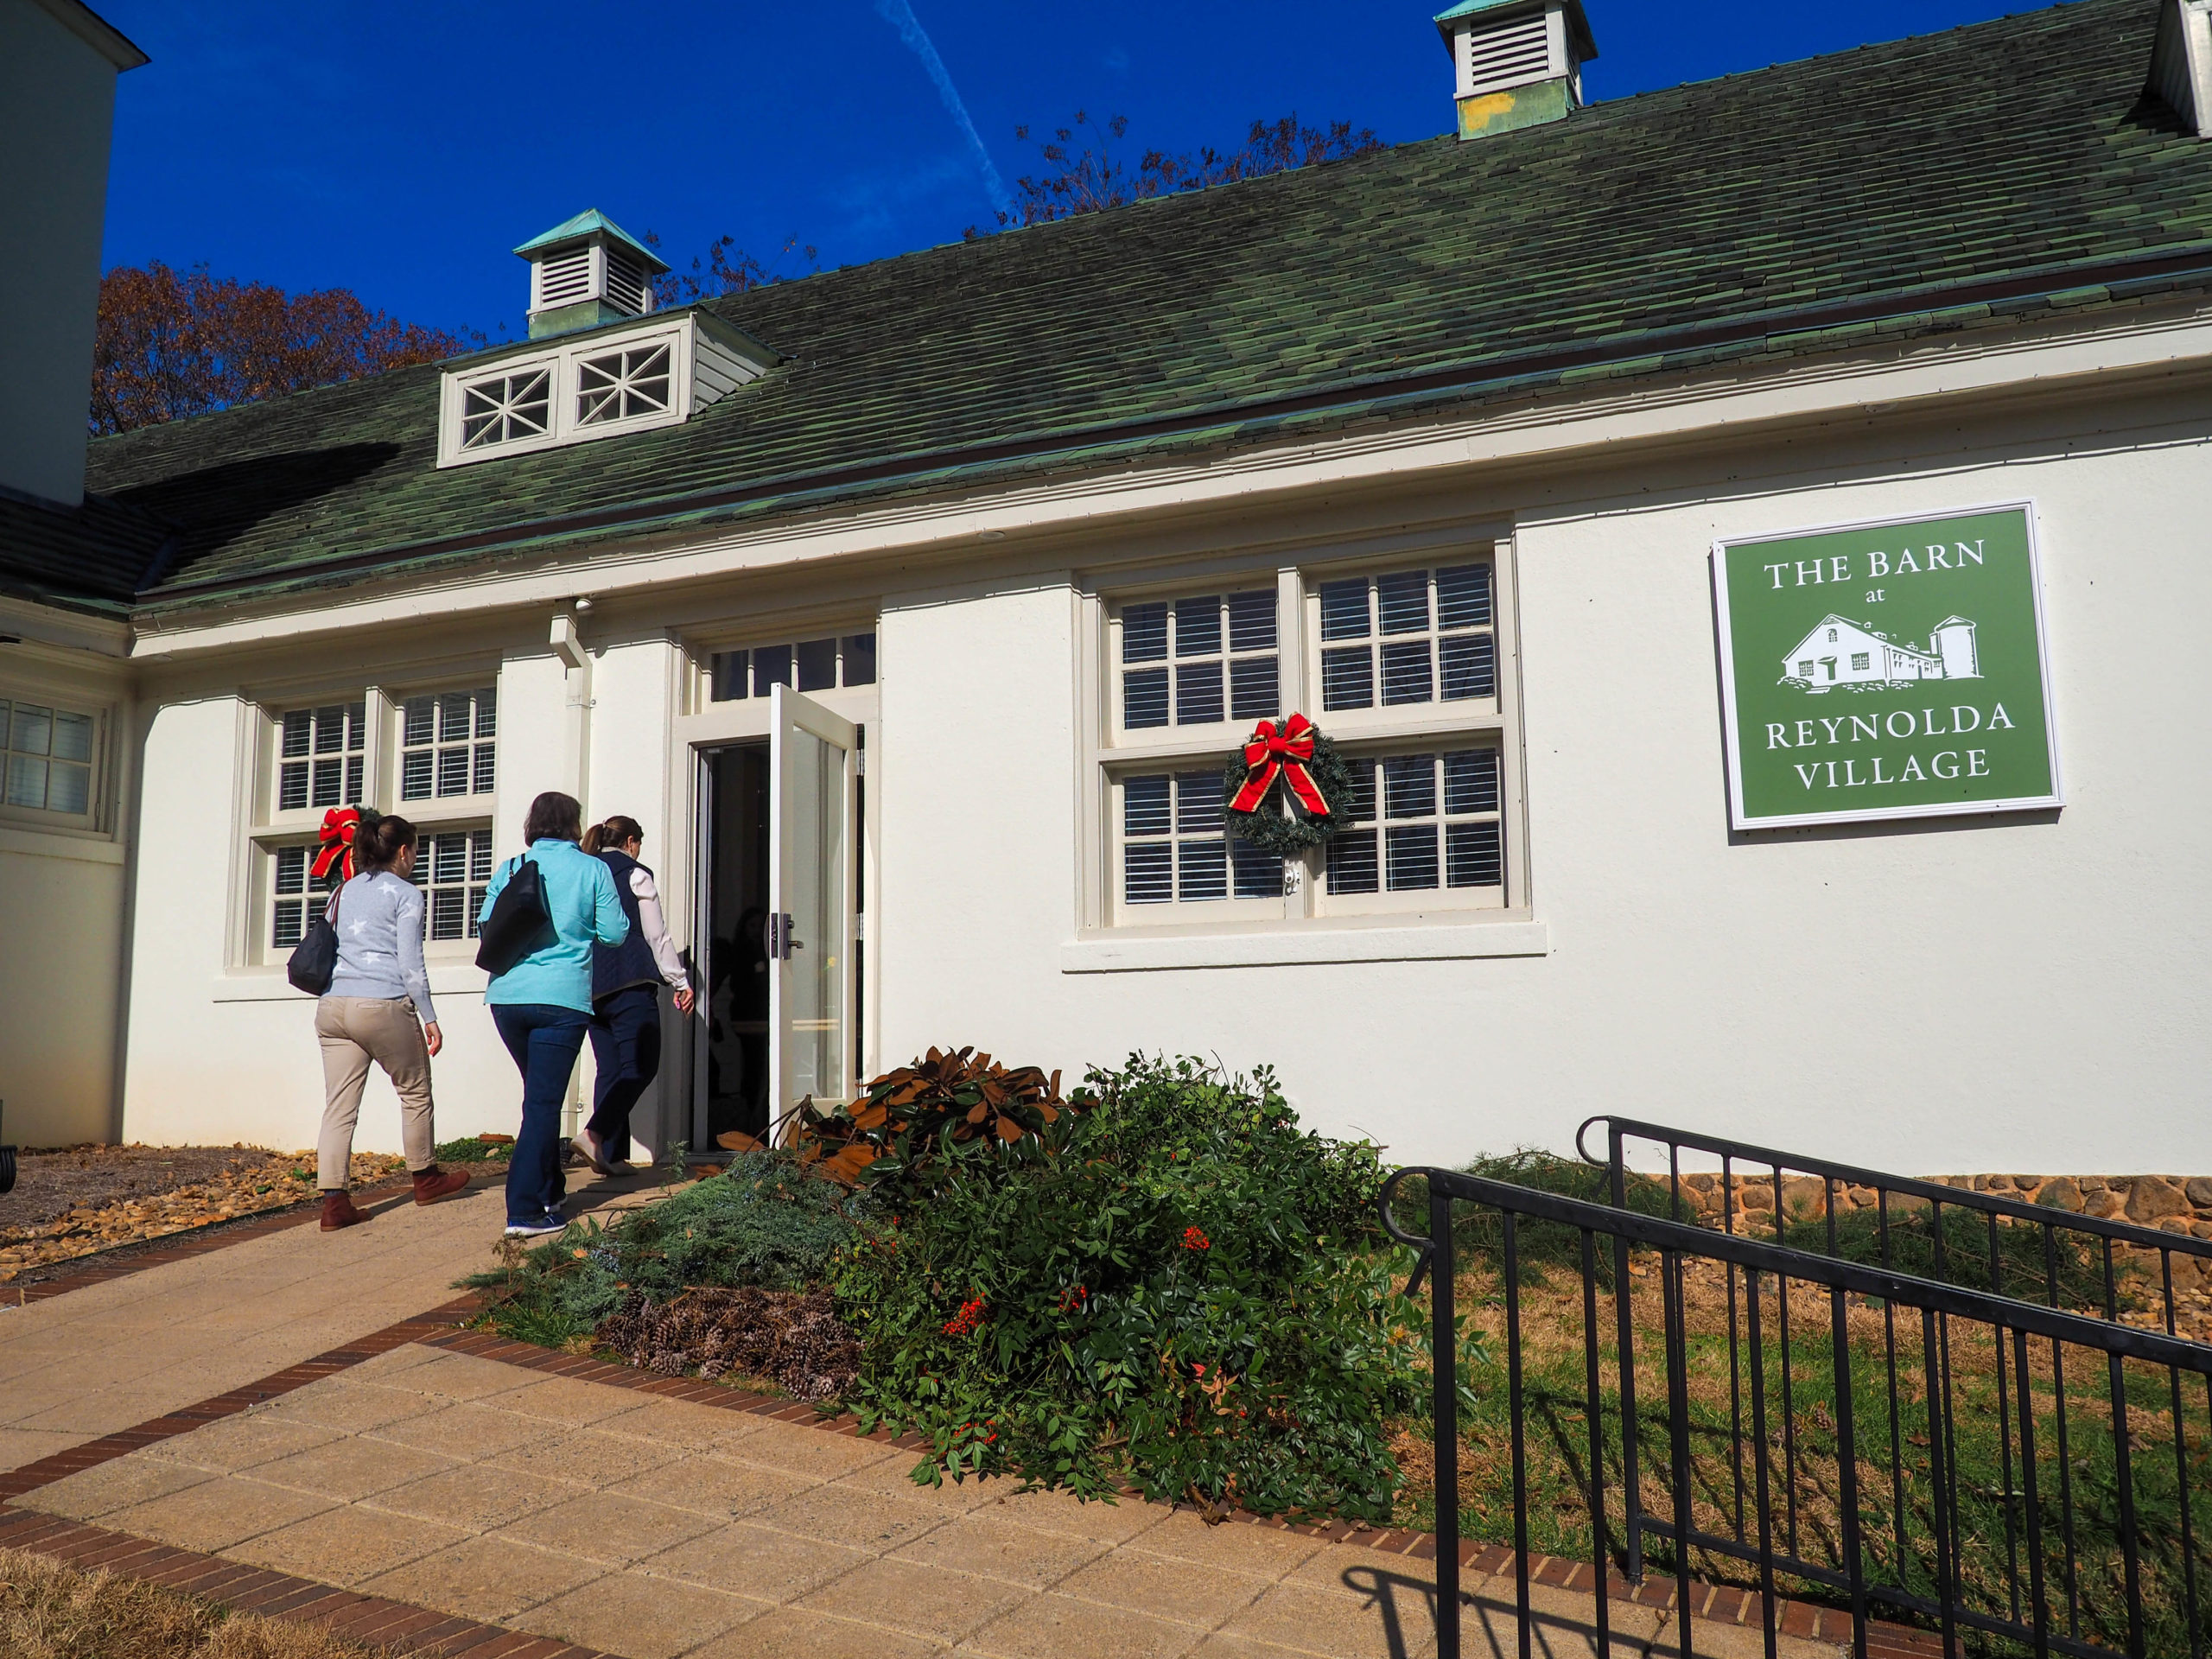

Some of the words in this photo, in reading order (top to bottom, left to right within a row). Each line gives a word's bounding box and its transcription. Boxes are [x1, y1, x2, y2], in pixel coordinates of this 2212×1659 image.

[1764, 556, 1852, 590] THE
[1867, 539, 1985, 578] BARN
[1866, 588, 1885, 603] at
[1765, 702, 2016, 750] REYNOLDA
[1794, 749, 1990, 791] VILLAGE
